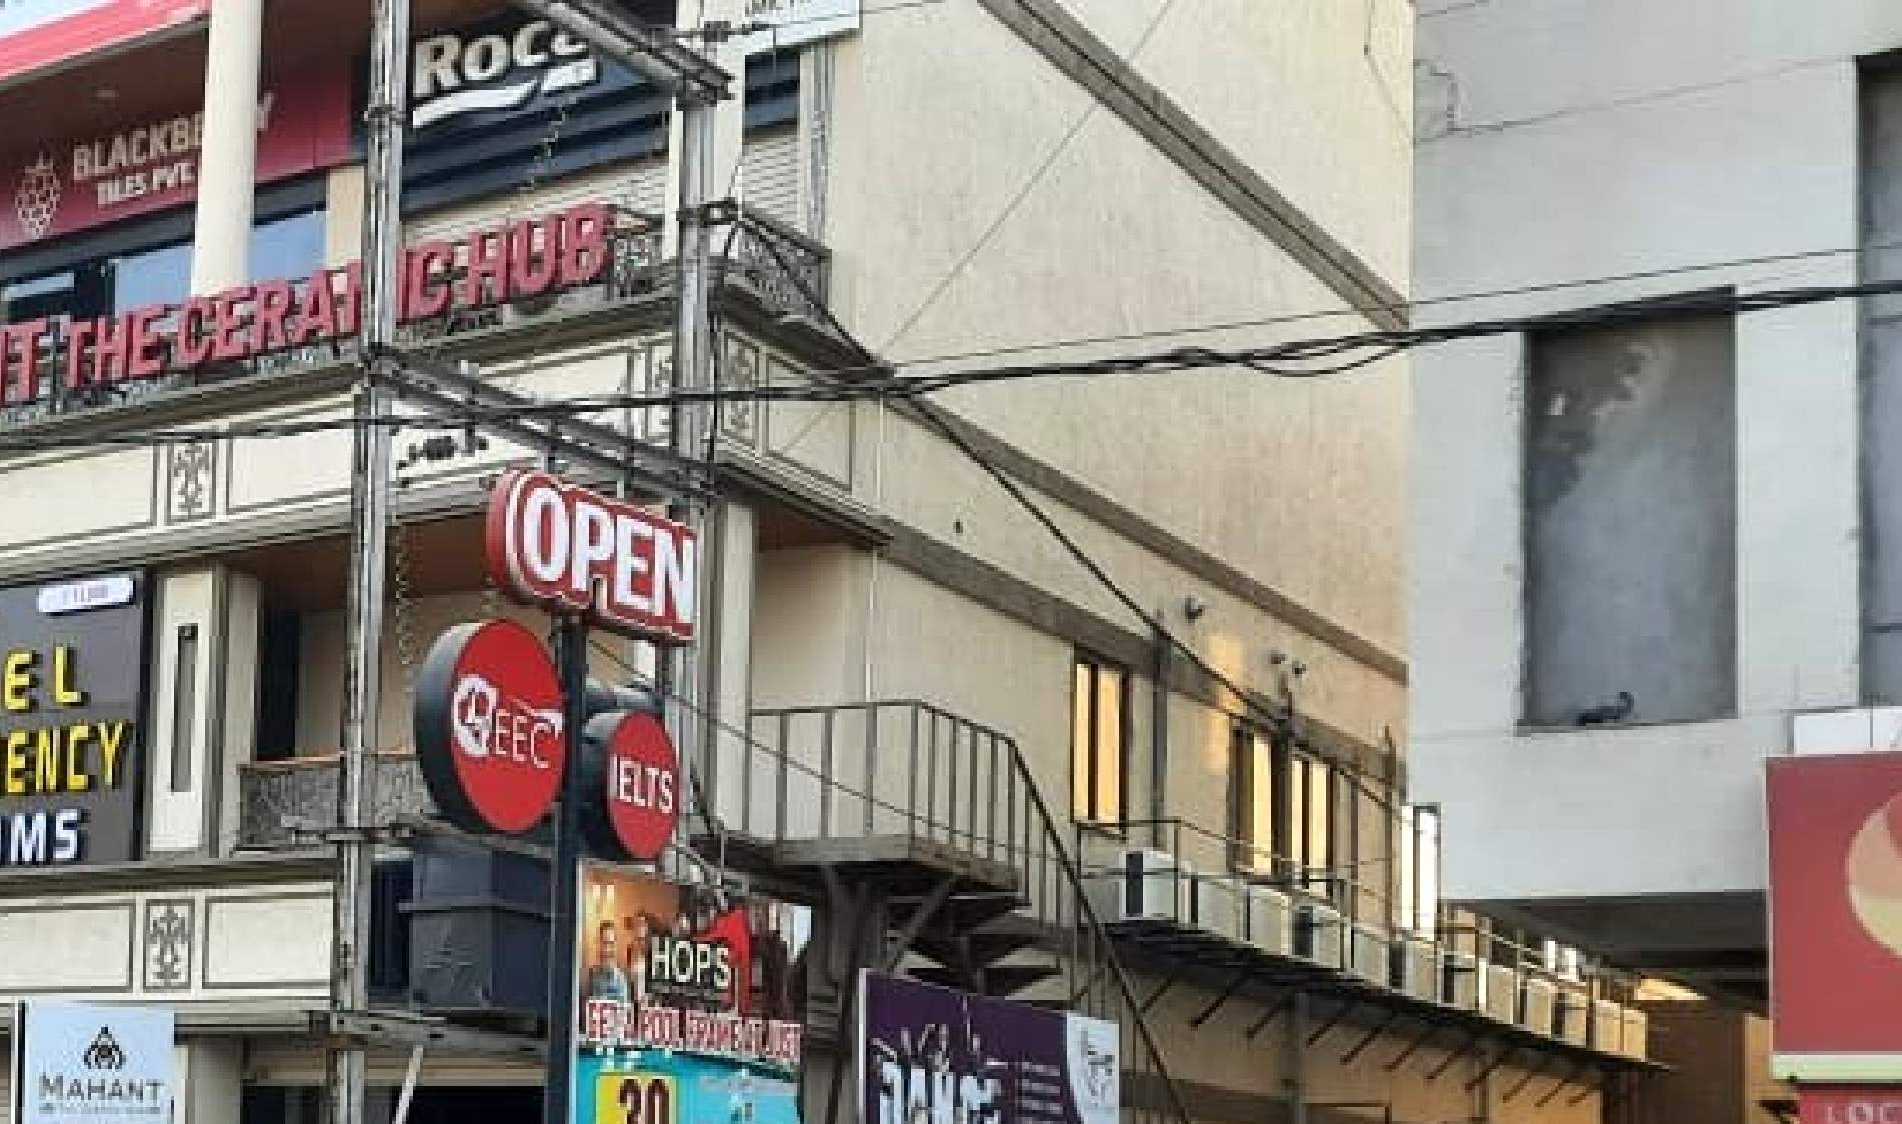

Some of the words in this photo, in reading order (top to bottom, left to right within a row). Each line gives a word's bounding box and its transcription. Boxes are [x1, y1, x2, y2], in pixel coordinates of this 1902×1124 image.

[72, 92, 274, 182] BLACKBEY
[97, 172, 147, 205] TILES
[64, 305, 166, 388] THE
[466, 201, 615, 310] HUB
[522, 487, 697, 625] OPEN
[611, 755, 674, 814] IELTS
[651, 936, 732, 987] HOPS
[38, 1073, 166, 1101] MAHANT
